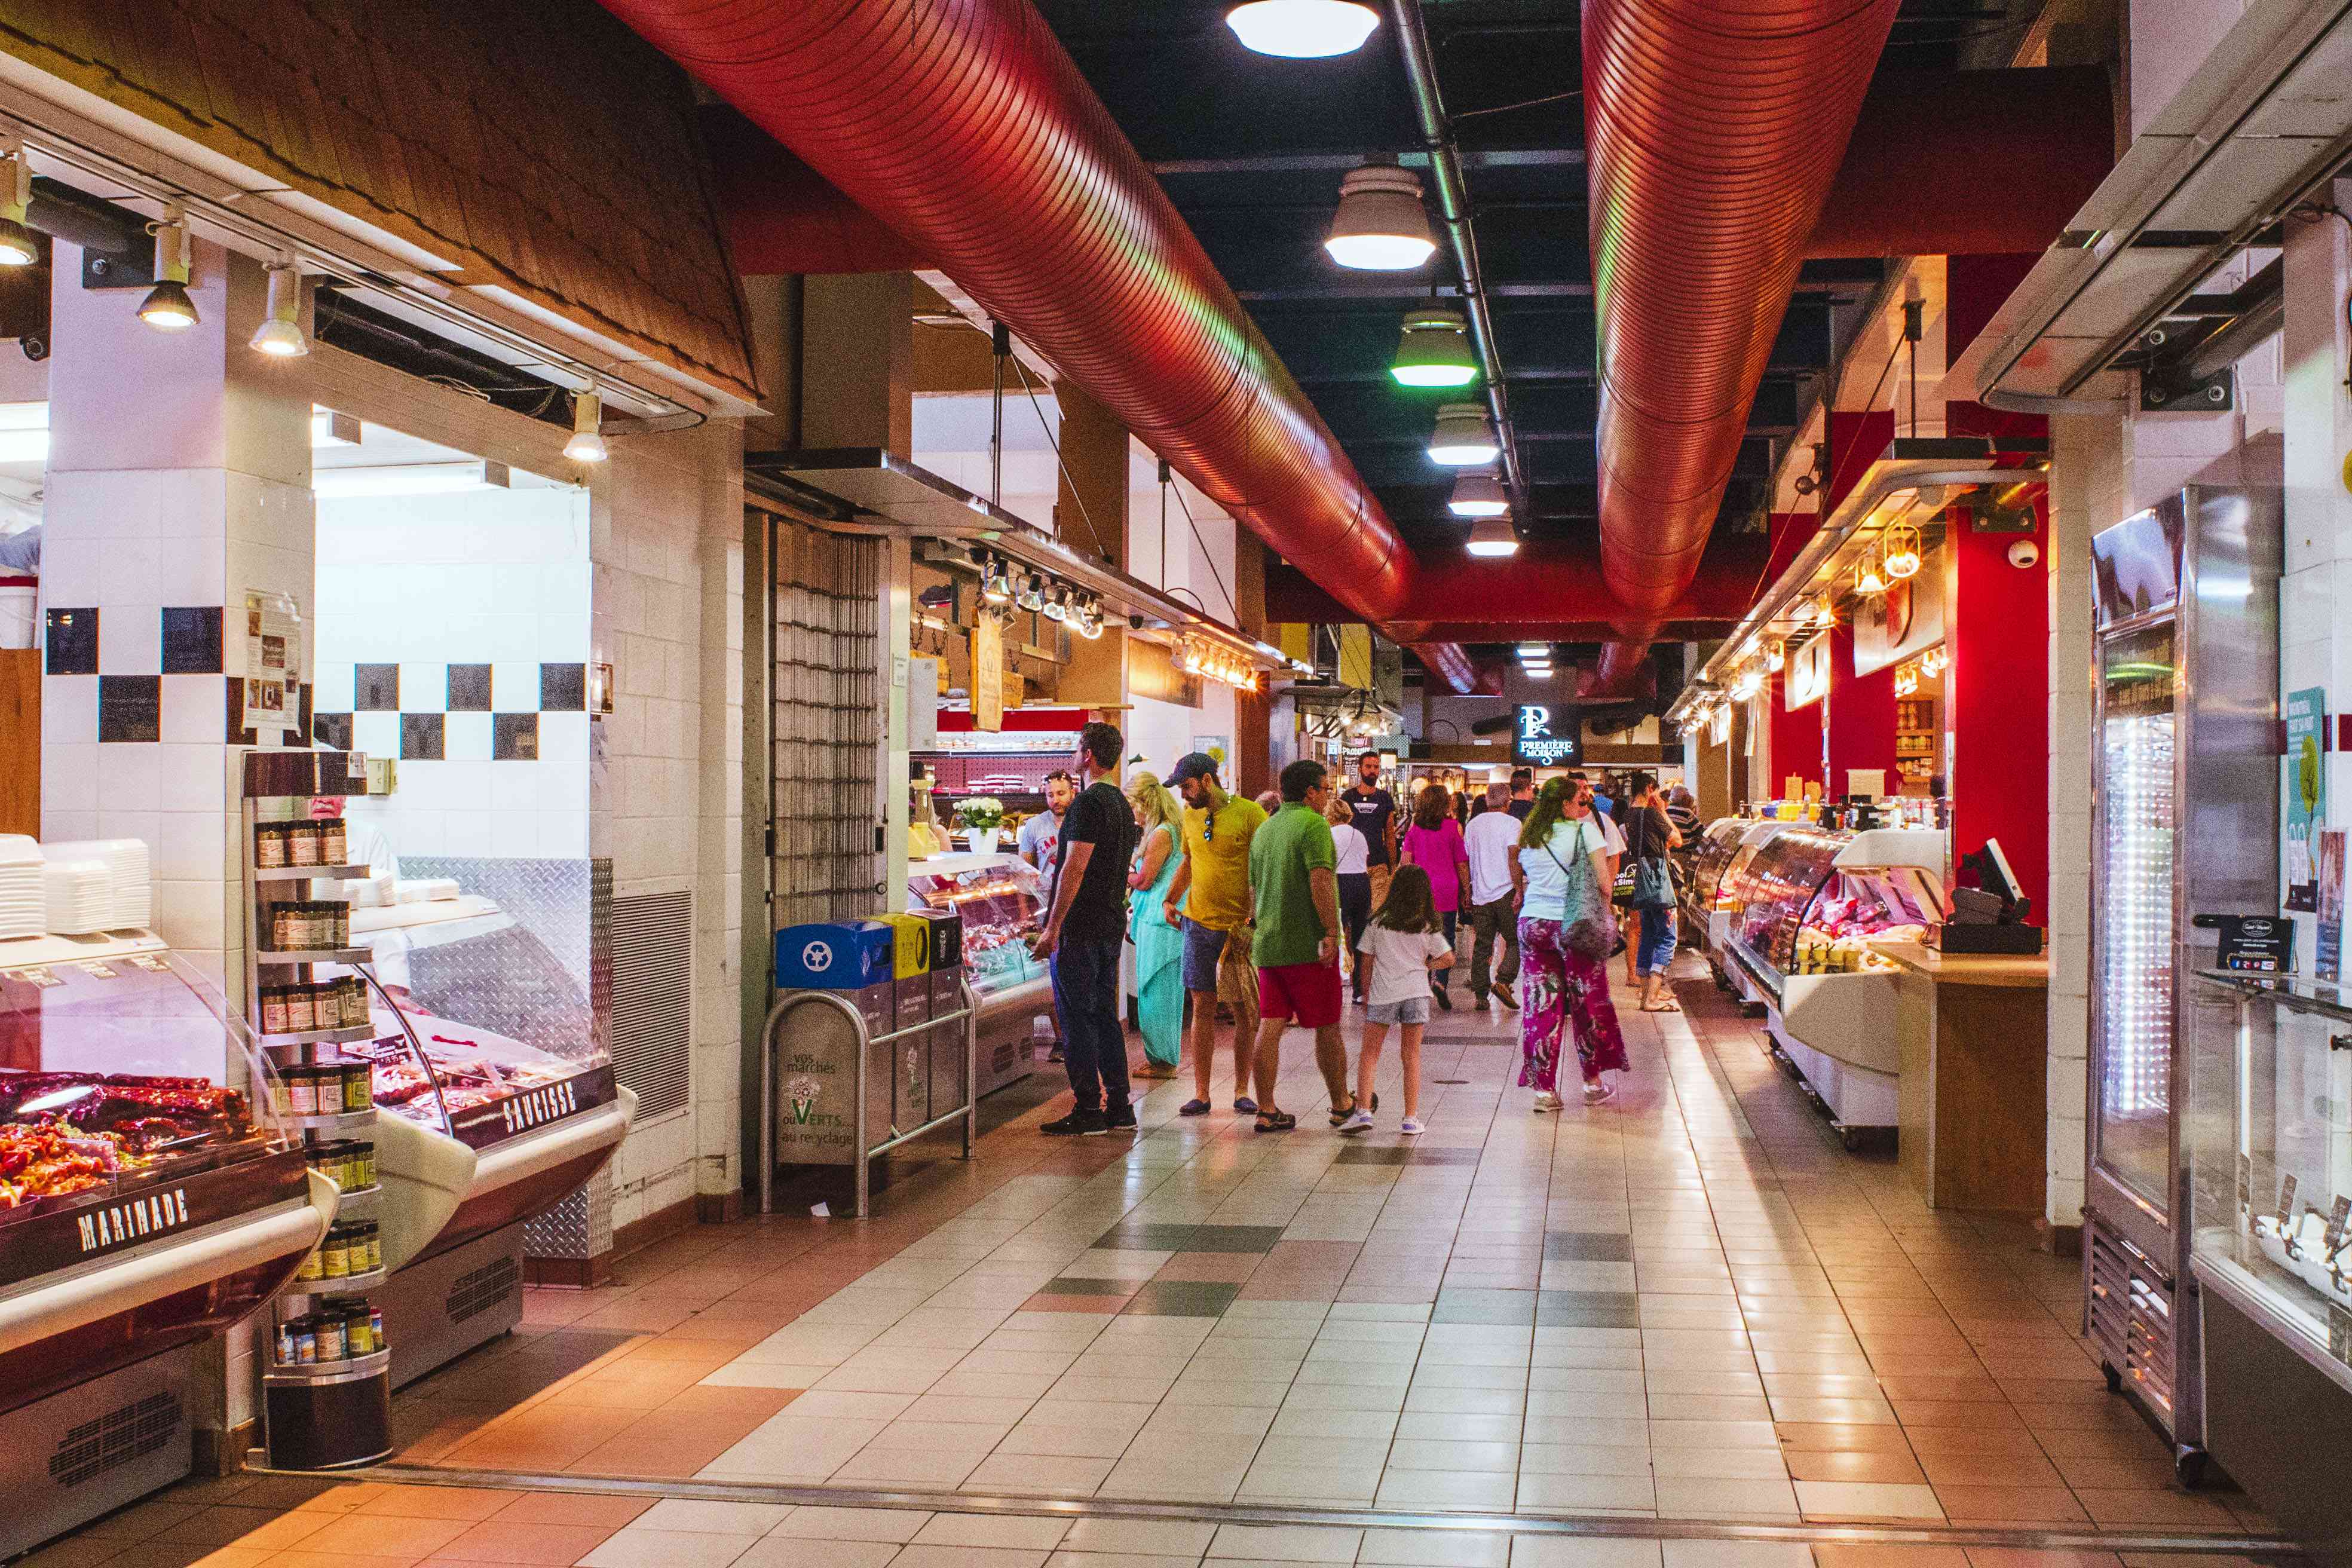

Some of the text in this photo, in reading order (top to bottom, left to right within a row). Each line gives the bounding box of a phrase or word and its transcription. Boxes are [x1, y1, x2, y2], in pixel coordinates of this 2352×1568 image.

[1520, 739, 1573, 752] PREMIÈRE
[1525, 749, 1563, 766] MOISON
[1040, 835, 1057, 854] CAN
[794, 1054, 814, 1063] vos
[503, 1080, 577, 1133] SAUCISSE
[782, 1131, 853, 1148] au reyclage
[77, 1188, 188, 1252] MARINADE
